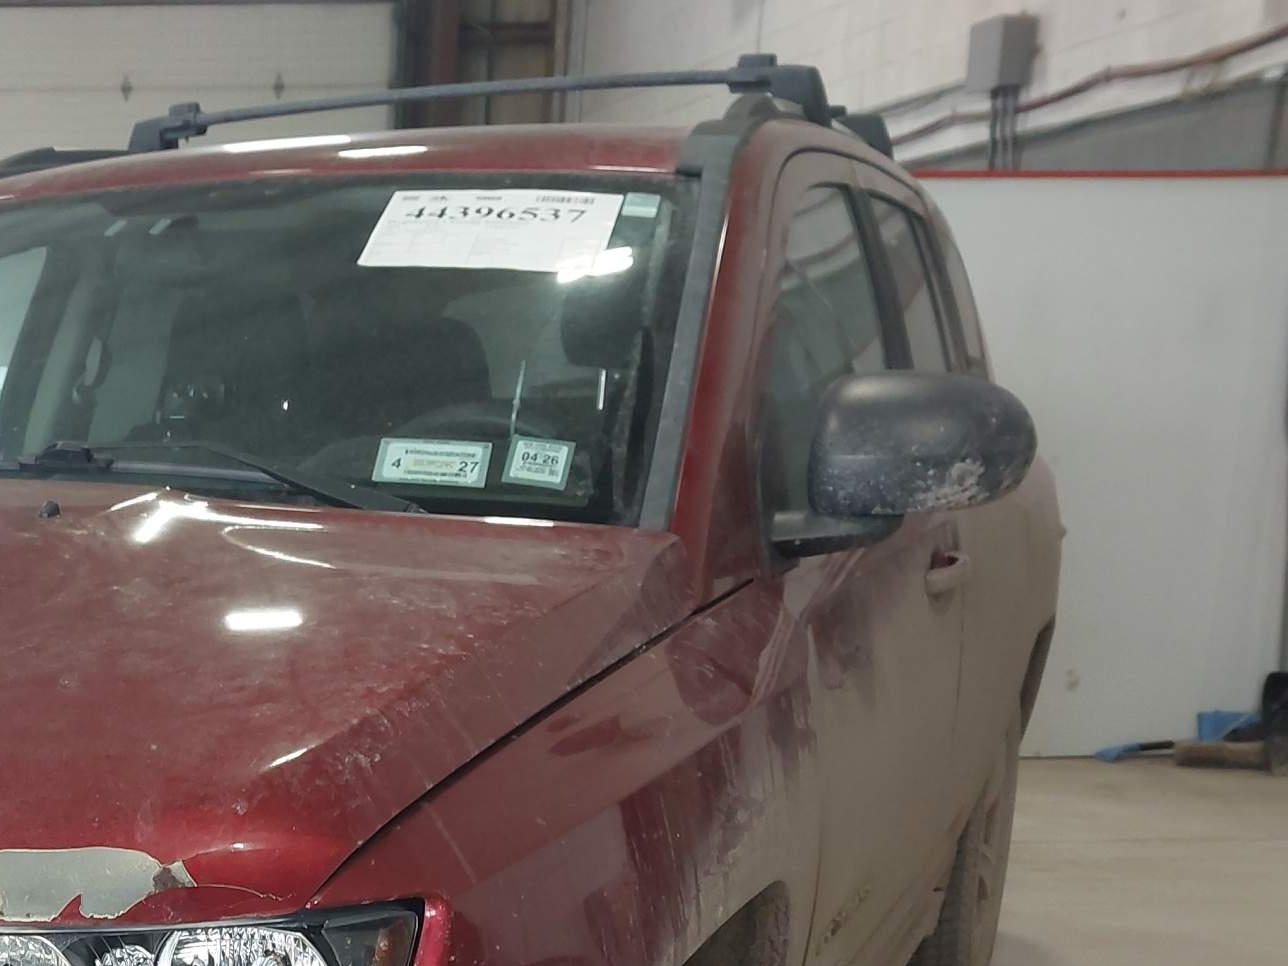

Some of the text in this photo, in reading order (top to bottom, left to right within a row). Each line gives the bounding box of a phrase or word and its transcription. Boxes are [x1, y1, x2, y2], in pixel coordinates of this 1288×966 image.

[406, 206, 587, 223] 44396537
[391, 457, 480, 473] 4 27
